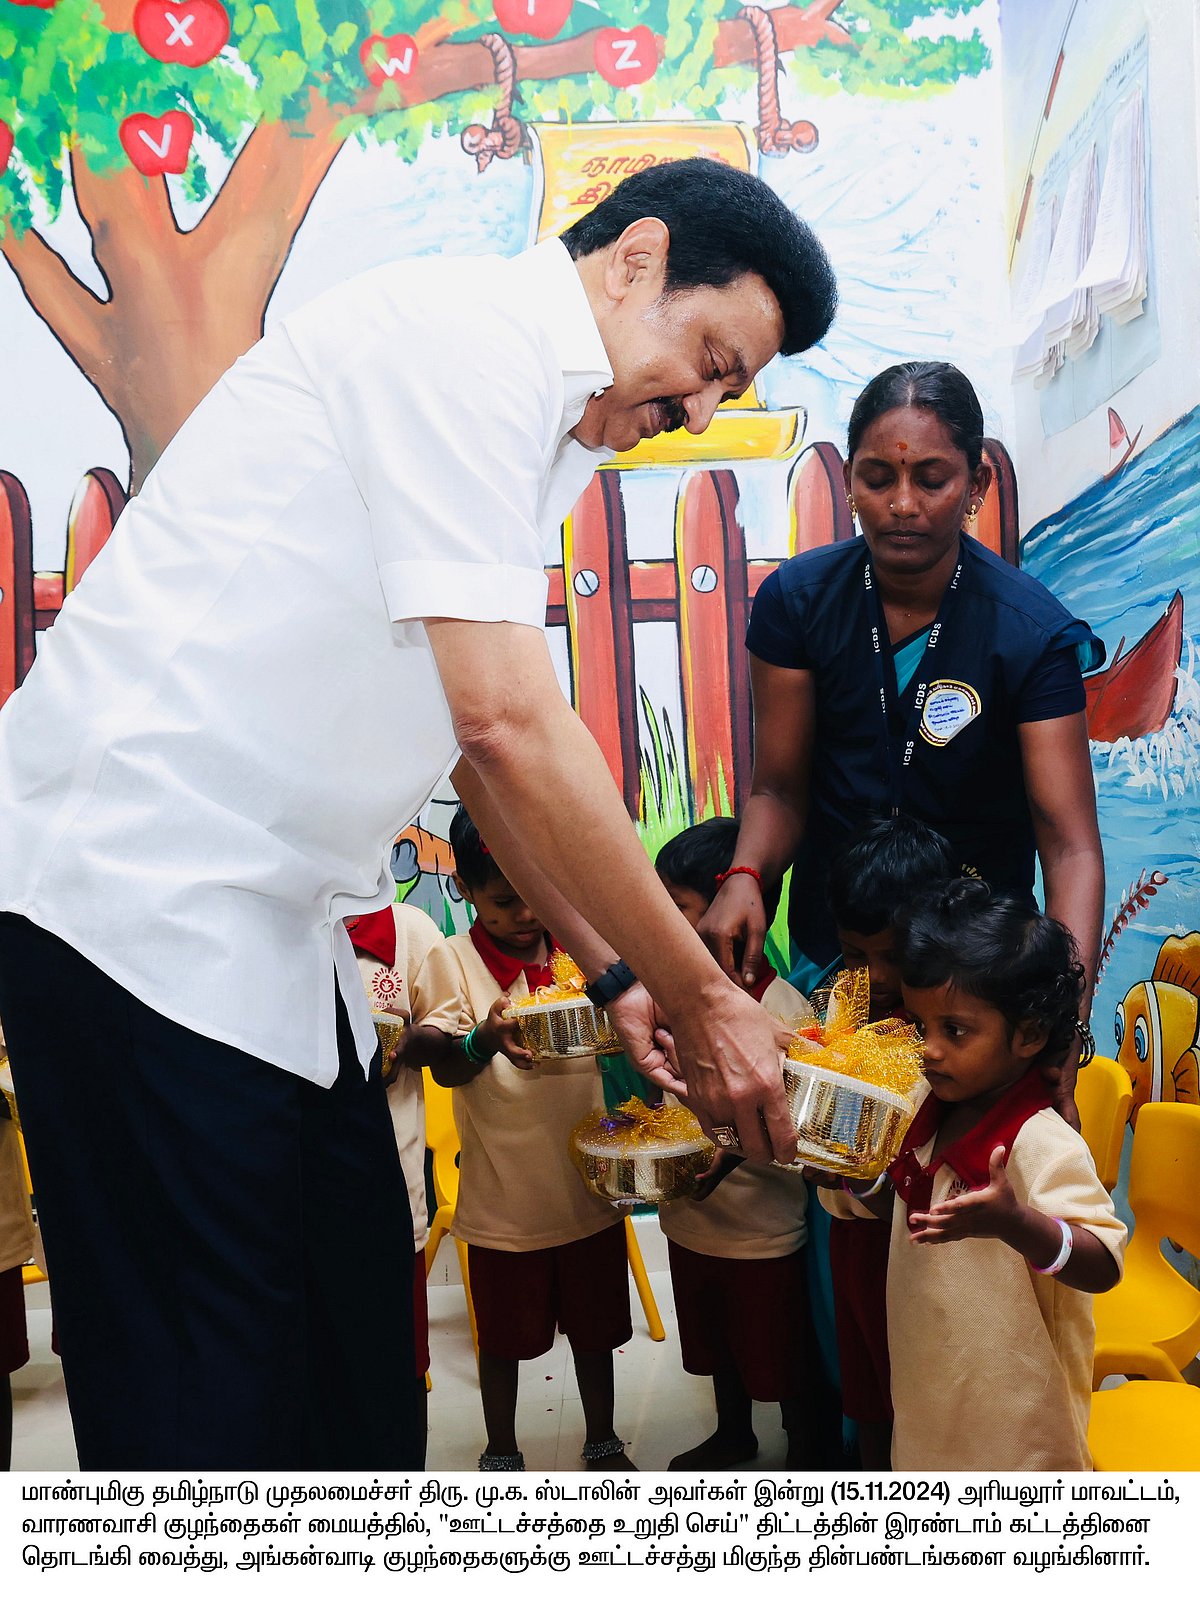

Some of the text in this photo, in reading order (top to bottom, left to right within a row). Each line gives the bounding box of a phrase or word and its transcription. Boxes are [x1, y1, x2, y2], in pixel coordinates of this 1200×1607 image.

[164, 12, 195, 46] X
[373, 48, 413, 77] W
[611, 39, 641, 70] Z
[138, 124, 171, 158] V
[864, 564, 872, 589] ICDS
[871, 627, 880, 652] ICDS
[928, 623, 941, 648] ICDS
[914, 683, 927, 709] ICDS
[903, 741, 914, 766] ICDS
